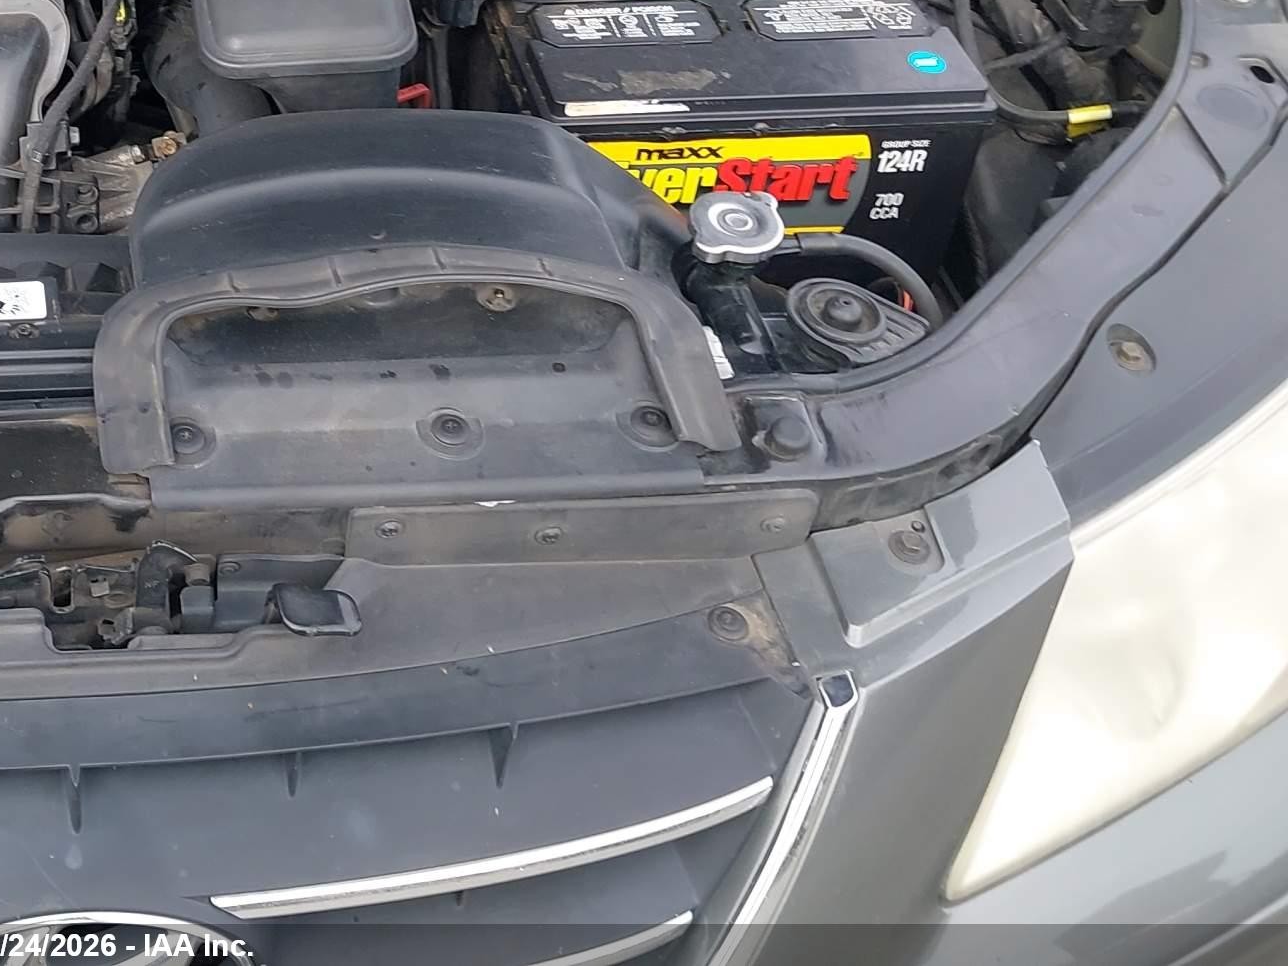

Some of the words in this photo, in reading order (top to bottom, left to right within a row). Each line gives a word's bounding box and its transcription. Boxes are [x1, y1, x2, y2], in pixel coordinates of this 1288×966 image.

[575, 7, 622, 15] DANGER
[636, 146, 725, 161] maxx
[877, 149, 928, 172] 124R
[614, 157, 857, 204] verStart
[875, 193, 904, 206] 700
[869, 207, 899, 219] CCA
